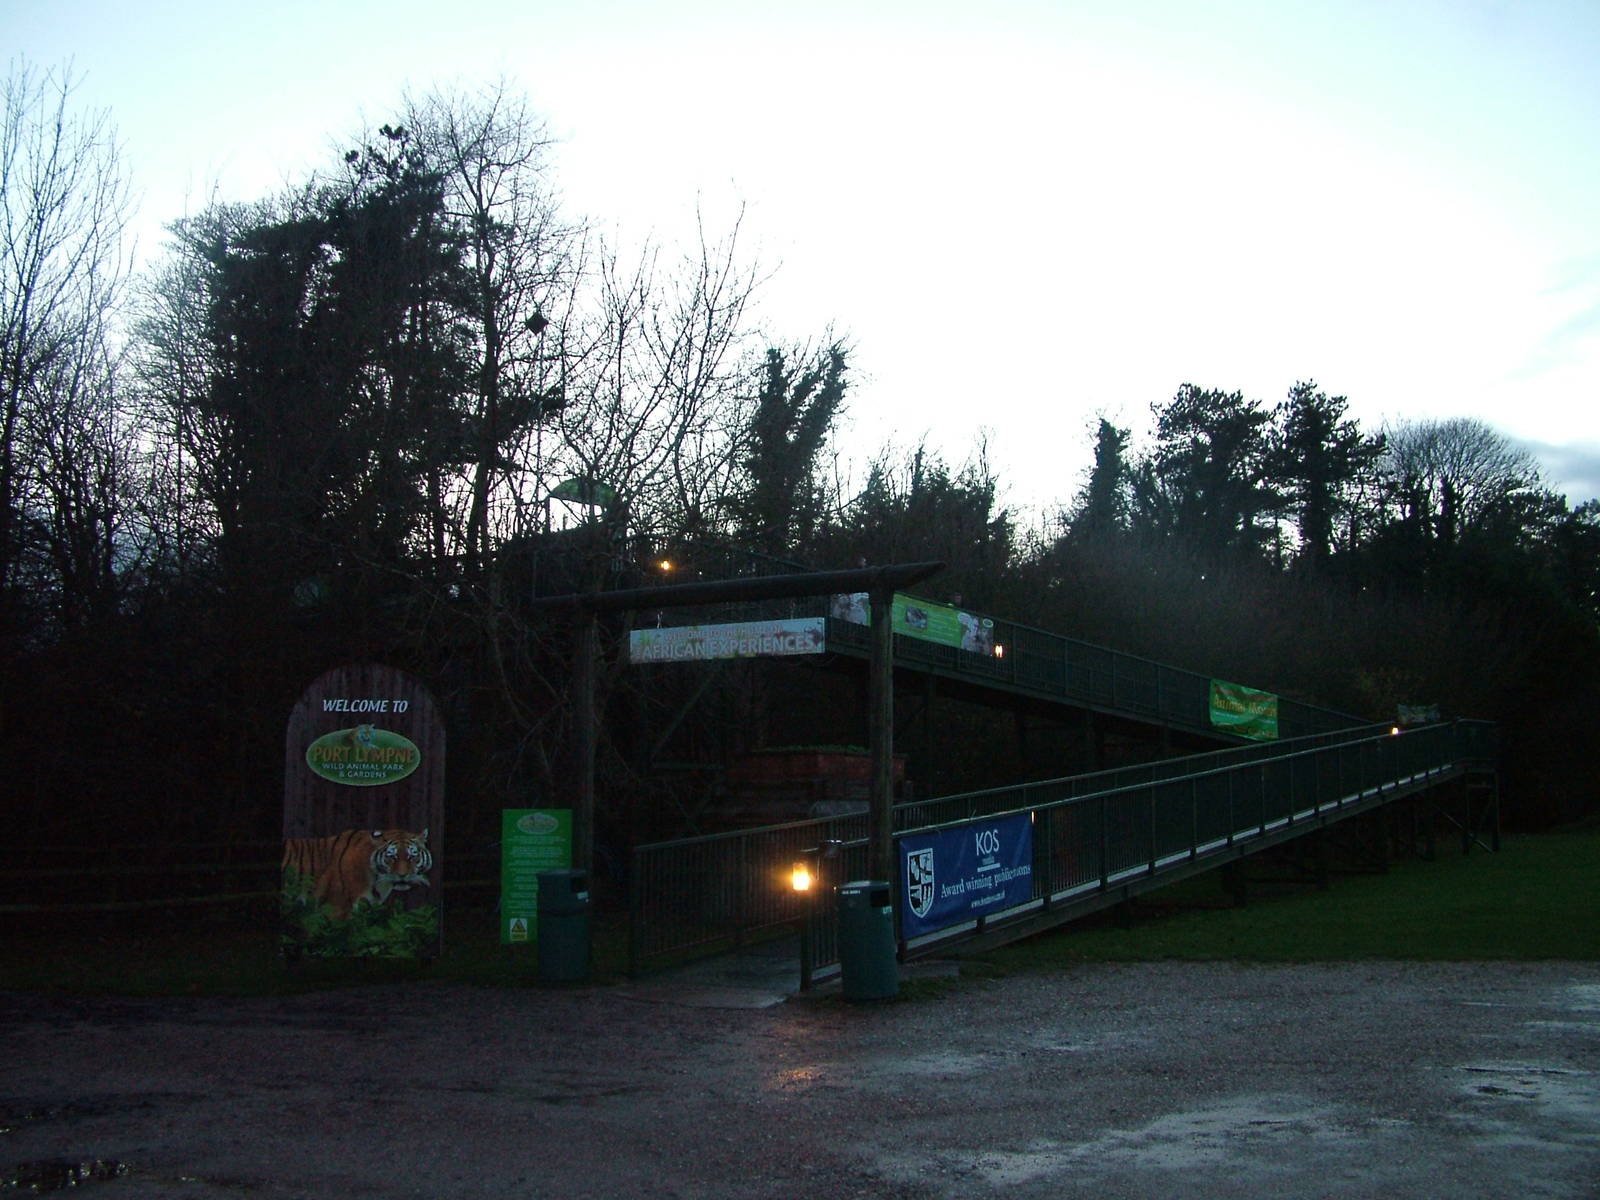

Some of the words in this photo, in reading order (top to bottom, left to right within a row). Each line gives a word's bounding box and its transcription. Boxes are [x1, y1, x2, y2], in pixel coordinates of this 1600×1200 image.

[642, 642, 706, 658] AFRICAN
[708, 634, 816, 656] EXPERIENCES
[322, 699, 389, 713] WELCOME
[392, 699, 409, 713] TO
[313, 746, 352, 763] PORT
[975, 828, 1000, 856] KOS
[941, 878, 965, 899] Award
[966, 874, 993, 889] winning
